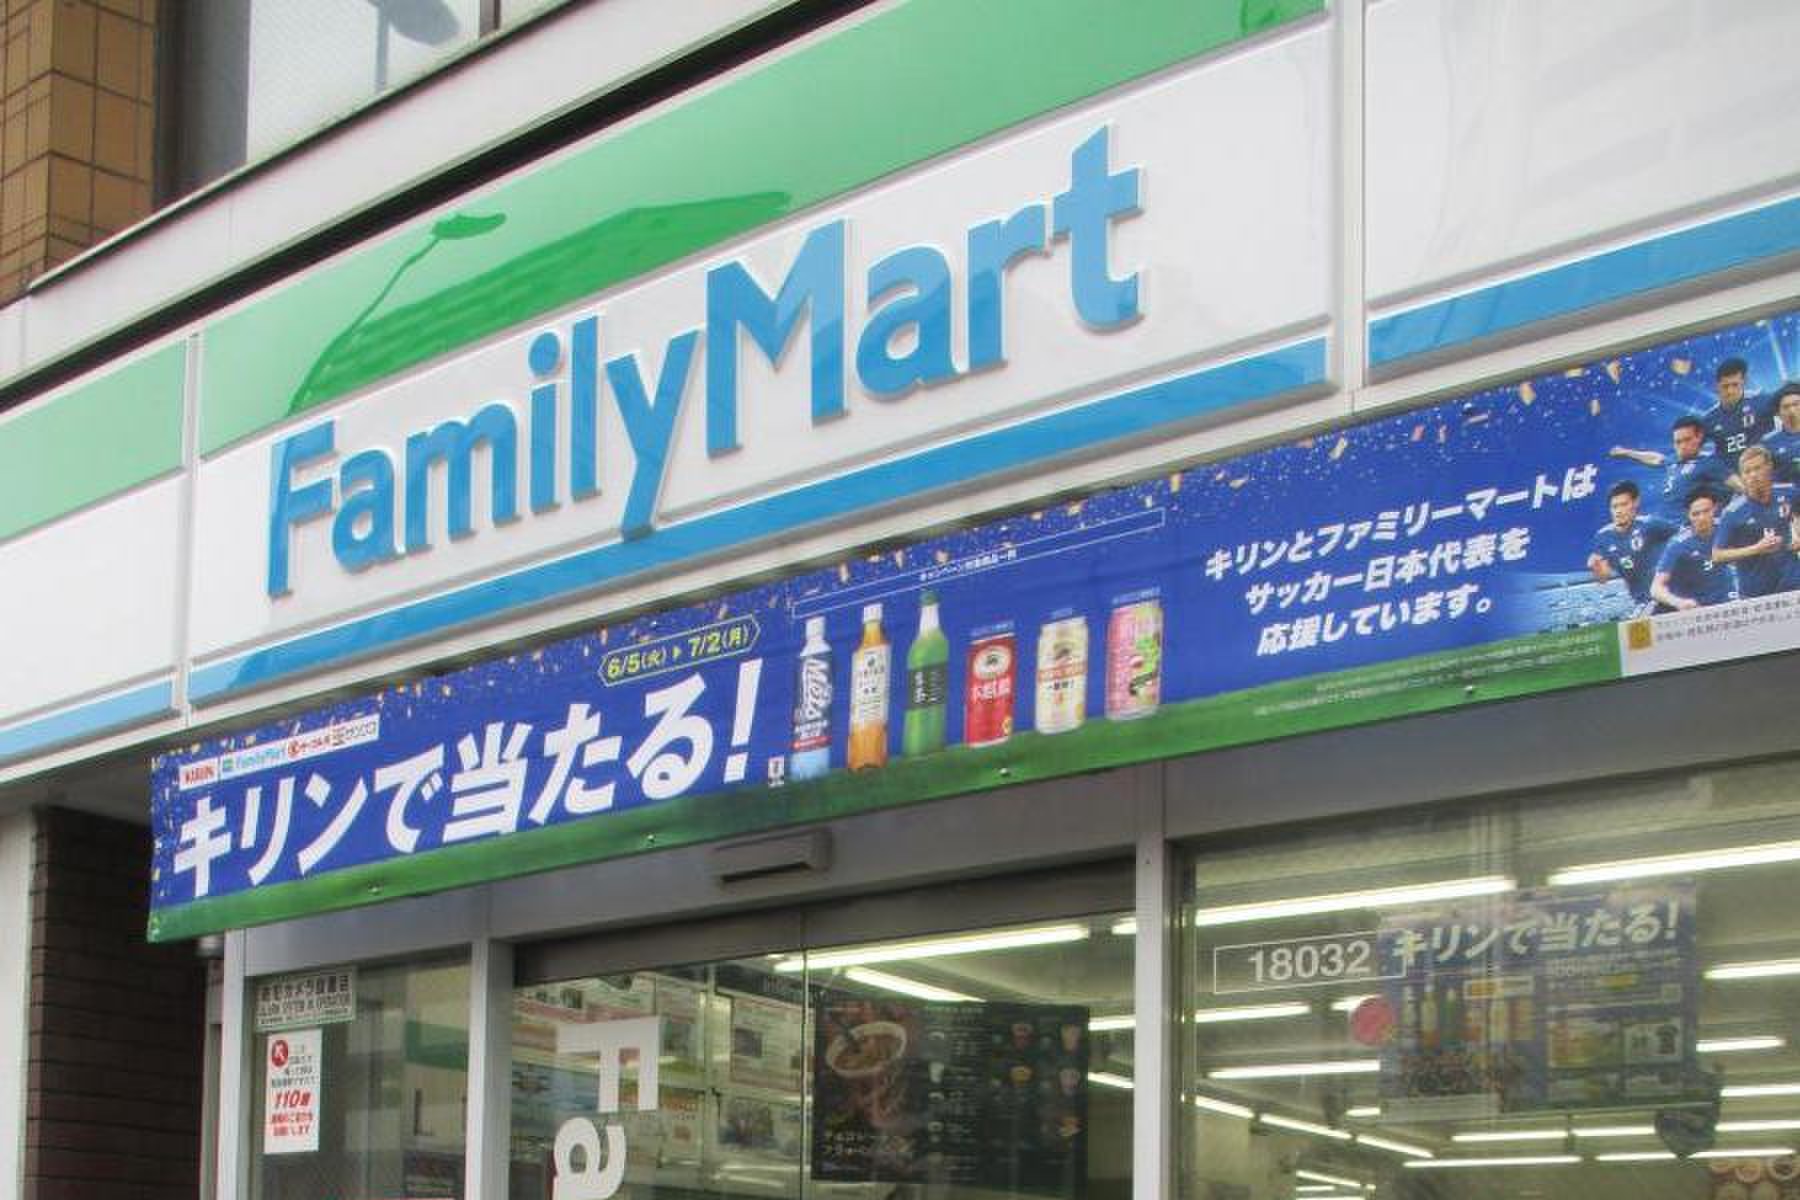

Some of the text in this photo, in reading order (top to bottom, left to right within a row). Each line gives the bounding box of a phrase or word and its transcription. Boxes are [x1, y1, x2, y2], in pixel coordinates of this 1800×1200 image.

[267, 122, 1144, 598] FamilyMart
[1203, 463, 1598, 580] キリンとファミリーマートは
[1244, 527, 1530, 616] サッカー日本代表を
[607, 624, 749, 679] 6/5(火) 7/2(月)
[1256, 584, 1491, 657] 応援しています。
[173, 659, 763, 898] キリンで当たる!
[1250, 940, 1371, 984] 18032
[1393, 900, 1681, 965] キリンで当たる!
